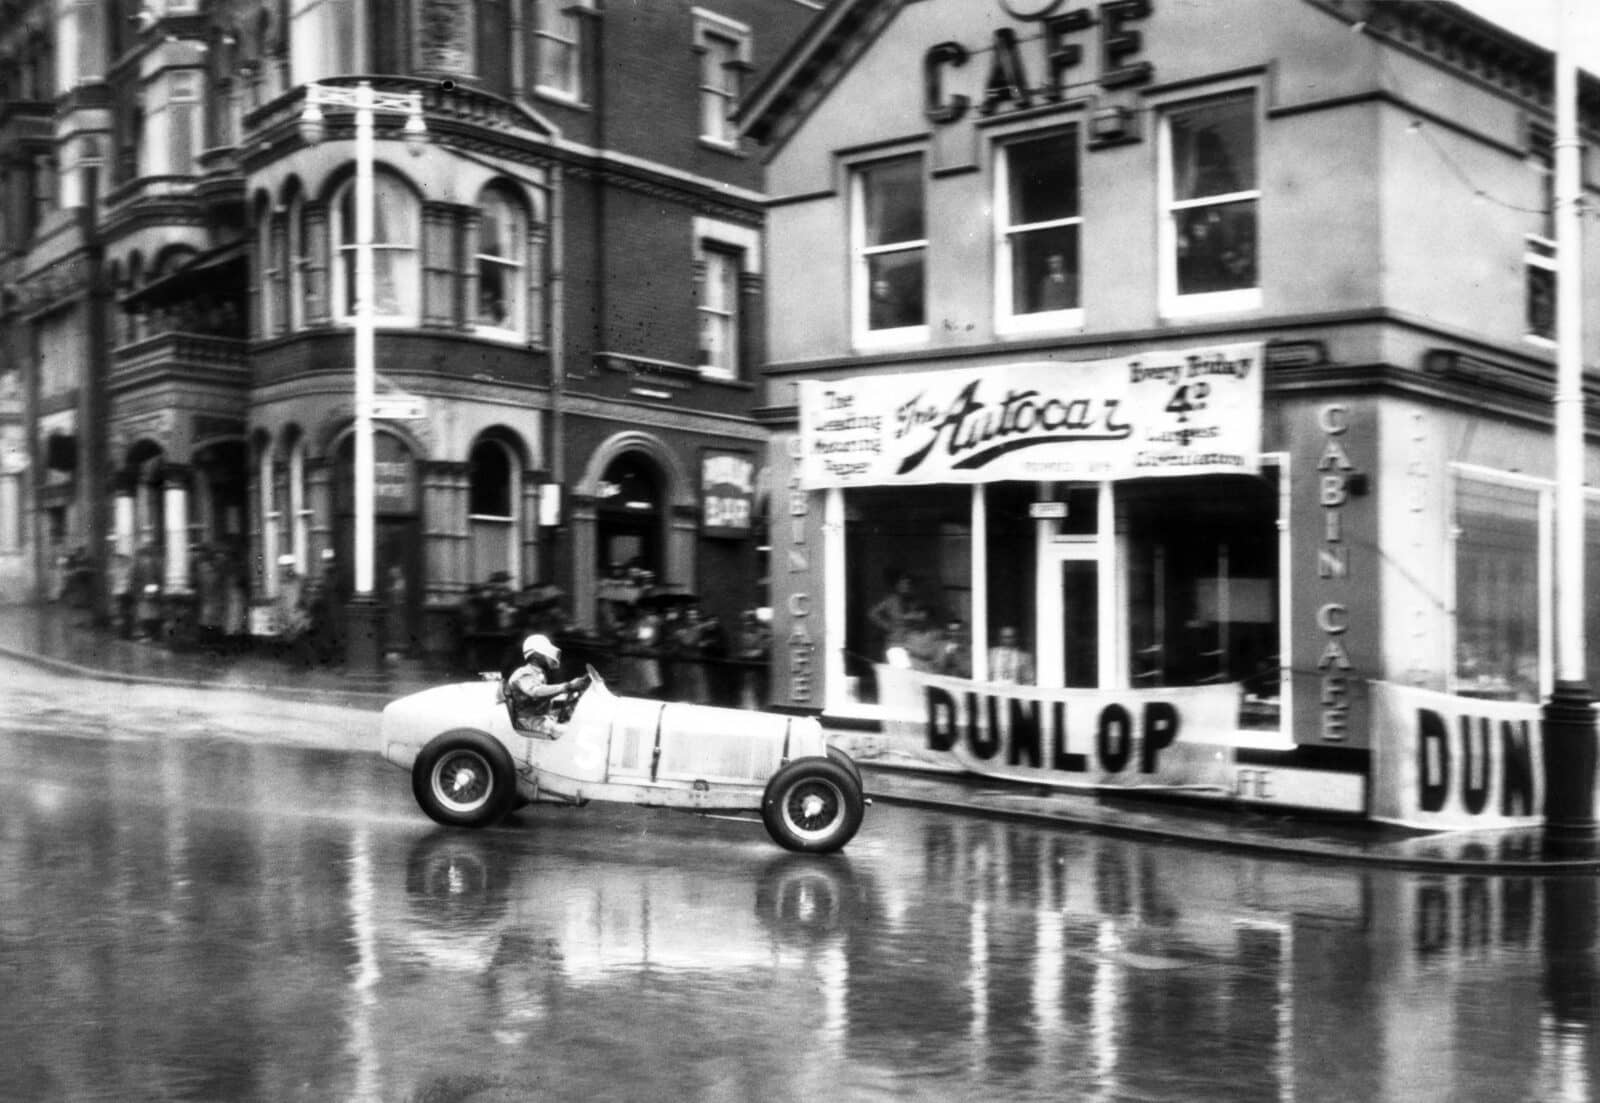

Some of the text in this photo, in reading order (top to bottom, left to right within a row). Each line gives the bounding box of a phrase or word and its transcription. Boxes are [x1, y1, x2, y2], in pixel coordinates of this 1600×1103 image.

[923, 0, 1154, 124] CAFE
[1128, 353, 1252, 385] Every Friday
[896, 379, 1133, 475] Autocar
[1317, 403, 1355, 742] CABIN CAFE
[924, 685, 1180, 774] DUNLOP
